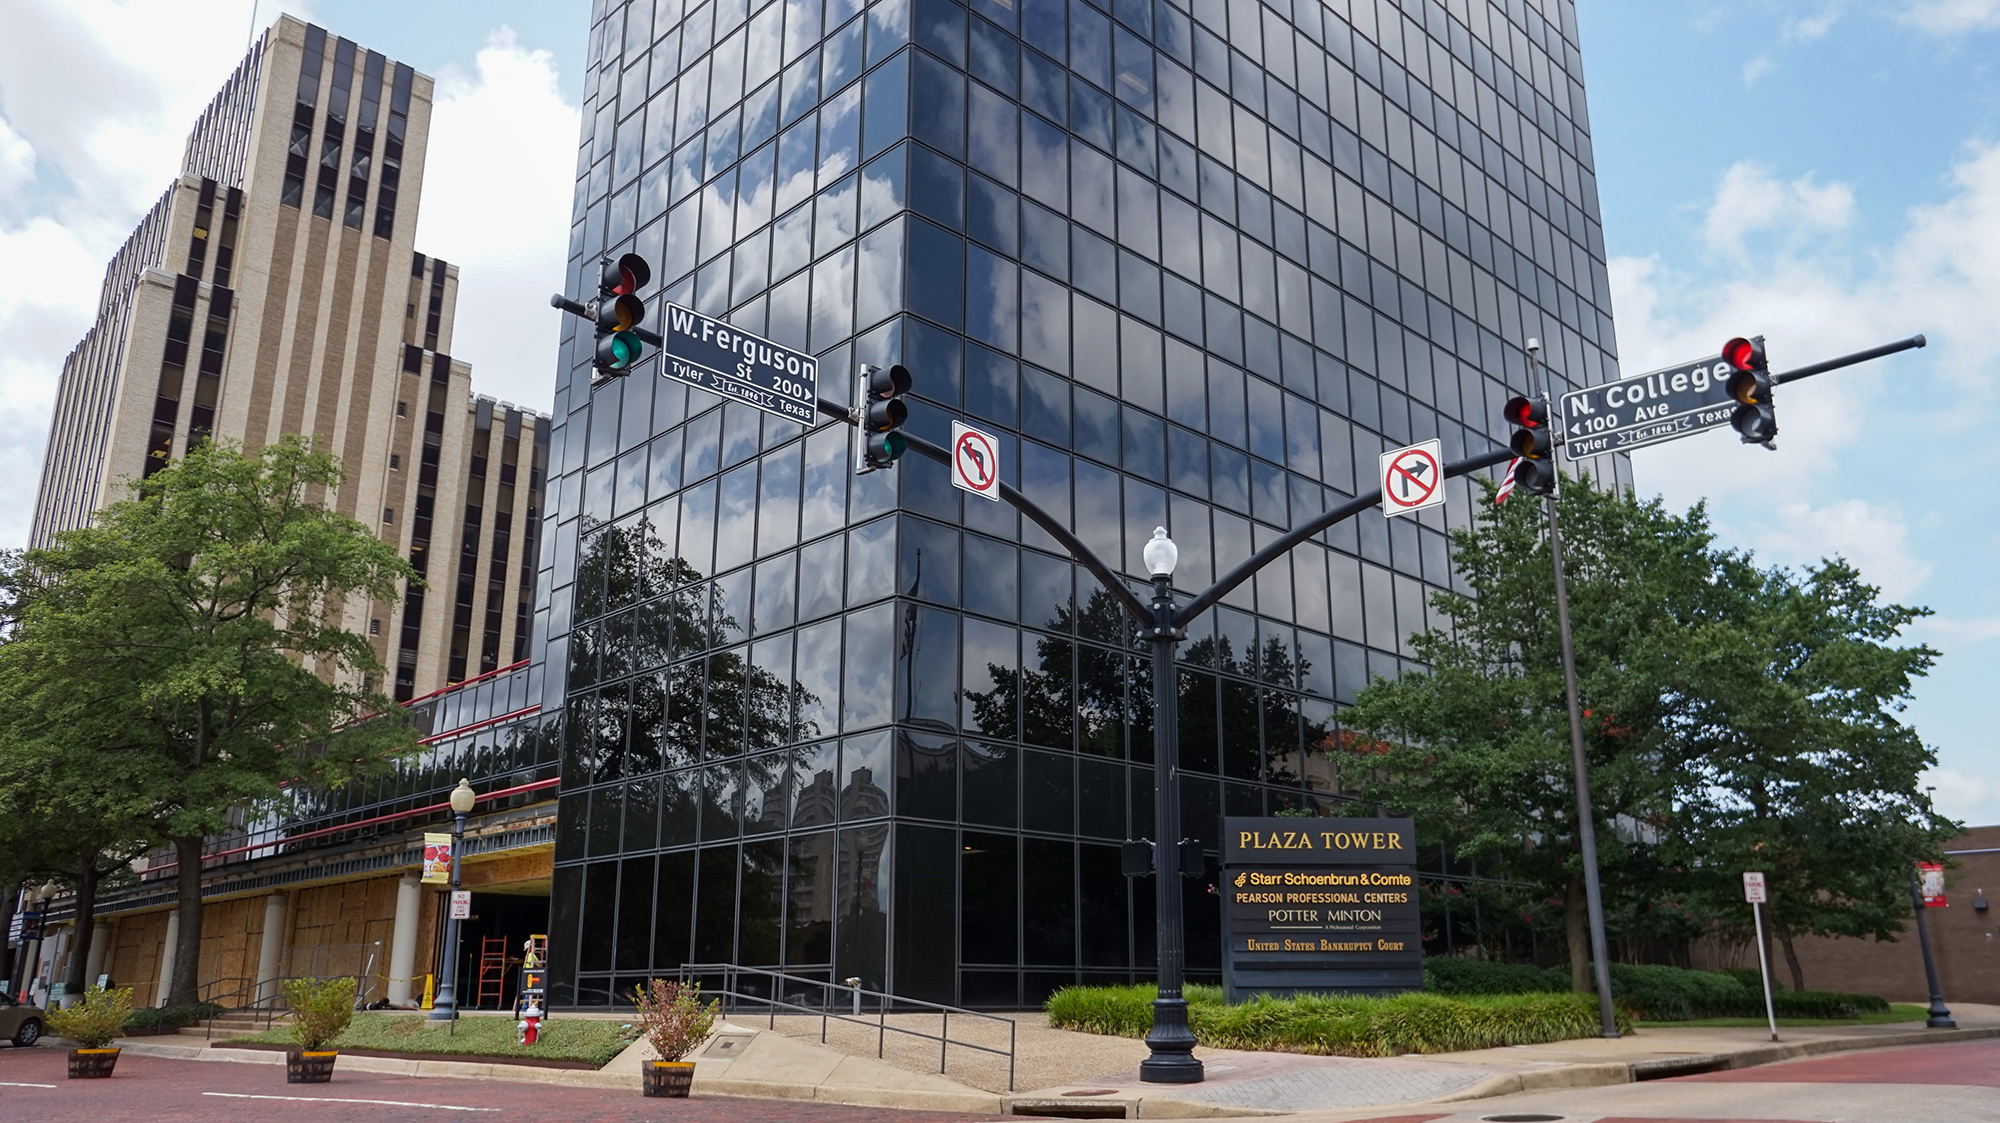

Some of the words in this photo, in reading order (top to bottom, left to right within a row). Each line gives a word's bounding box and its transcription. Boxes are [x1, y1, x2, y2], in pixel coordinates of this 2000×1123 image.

[672, 361, 704, 382] Tyler
[727, 383, 739, 394] Est.
[741, 388, 758, 400] 1846
[779, 399, 811, 419] Texas
[736, 363, 752, 381] St
[772, 376, 802, 398] 200
[1570, 394, 1595, 417] N.
[1606, 361, 1731, 408] College
[1585, 413, 1618, 433] 100
[1634, 402, 1669, 422] Ave
[1574, 436, 1608, 454] Tyler
[1651, 424, 1673, 436] 1846
[1239, 831, 1313, 849] PLAZA
[1320, 832, 1402, 850] TOWER
[1250, 872, 1282, 886] Starr
[1284, 872, 1359, 886] Schoenbrun
[1360, 872, 1370, 886] &
[1370, 872, 1411, 886] Comte
[1236, 893, 1283, 904] PEARSON
[1286, 893, 1360, 904] PROFESSIONAL
[1364, 893, 1407, 904] CENTERS
[1268, 910, 1318, 922] POTTER
[1327, 910, 1381, 922] MINTON
